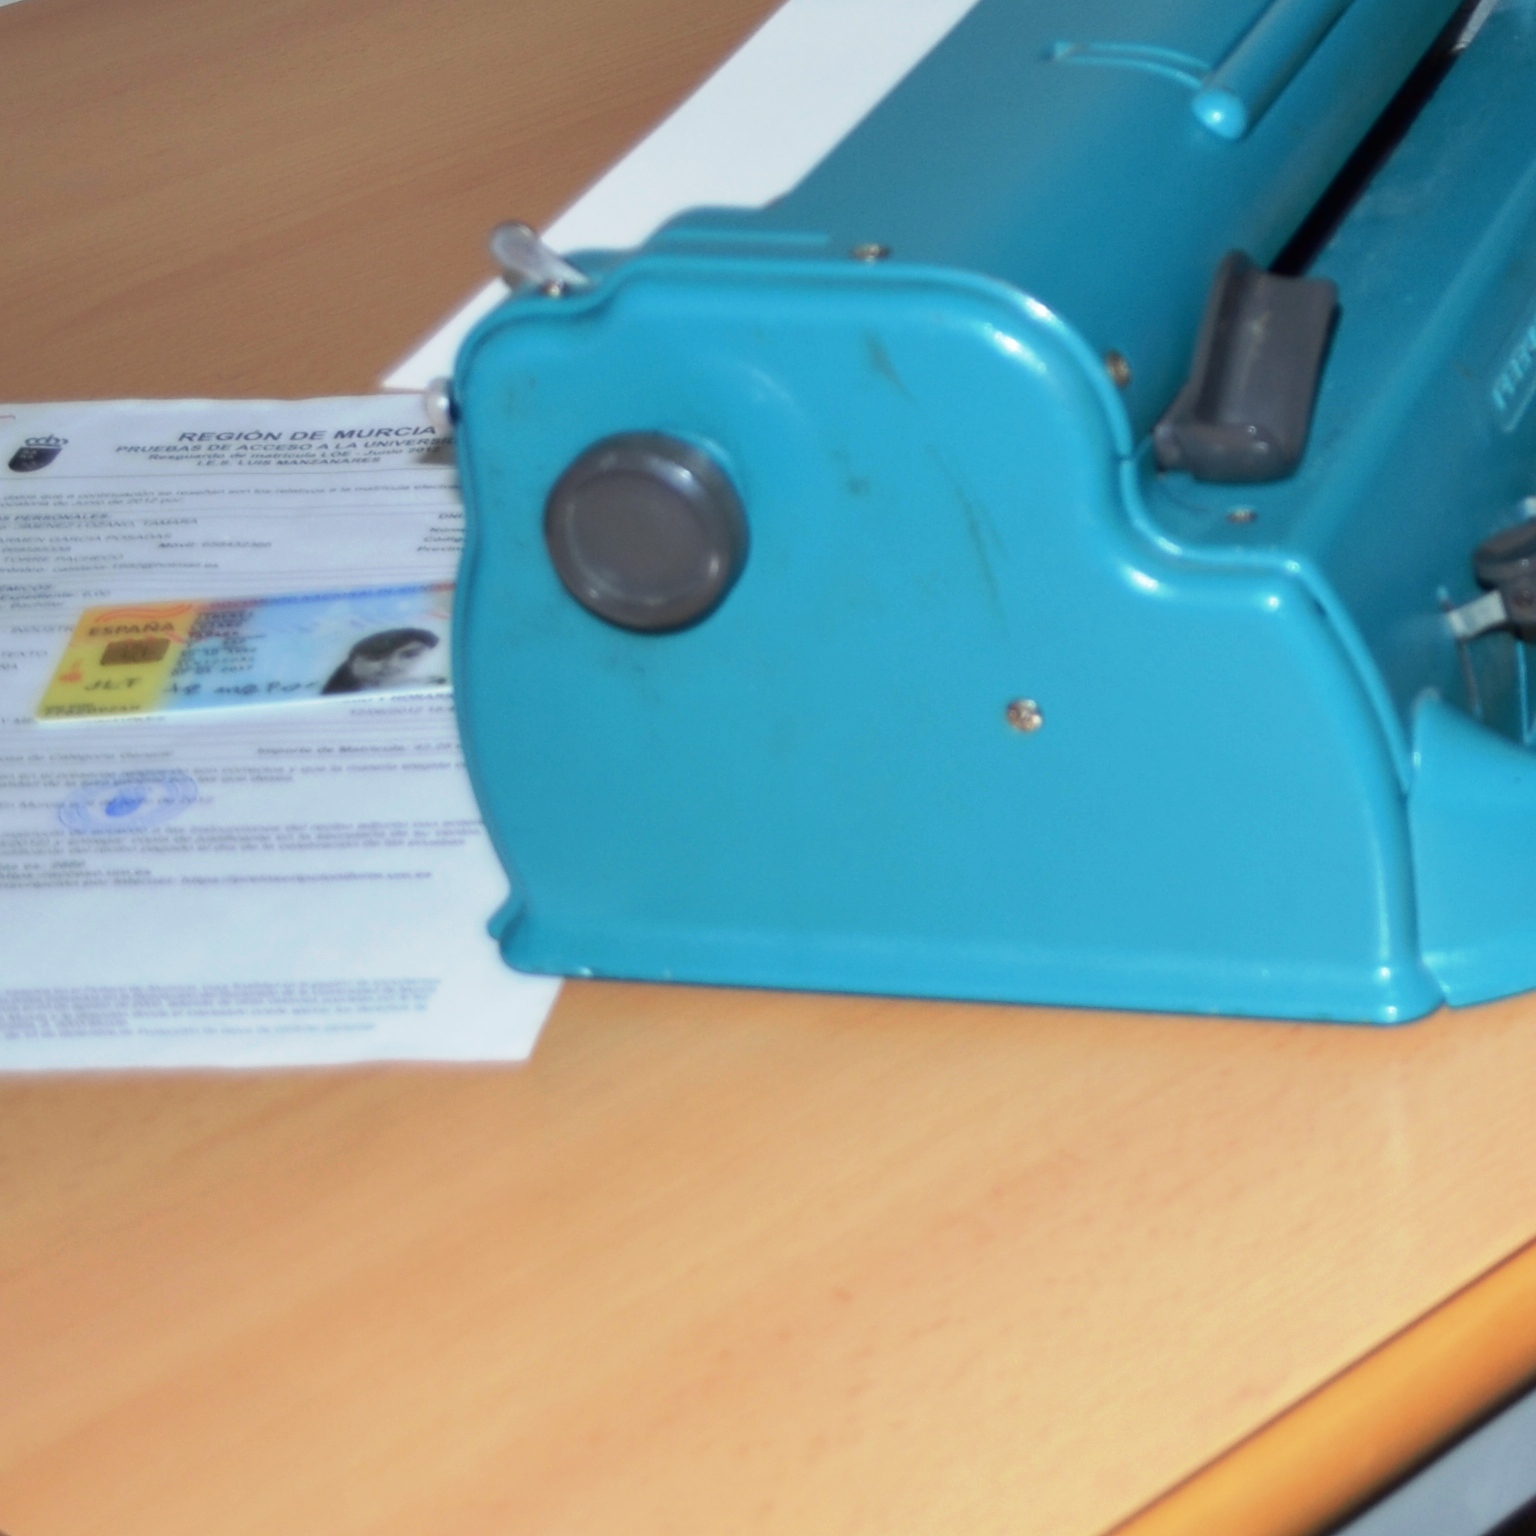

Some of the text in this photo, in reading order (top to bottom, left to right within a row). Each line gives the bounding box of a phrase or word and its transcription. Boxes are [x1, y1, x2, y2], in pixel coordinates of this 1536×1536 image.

[178, 425, 437, 443] REGIÓN DE MURCIA
[115, 444, 202, 453] PRUEBAS
[207, 444, 236, 452] DE
[238, 442, 313, 451] ACCESO
[317, 442, 329, 450] A
[333, 441, 357, 449] LA
[238, 458, 271, 466] LUIS
[276, 456, 381, 466] MANZANARES
[88, 621, 176, 636] ESPAÑA
